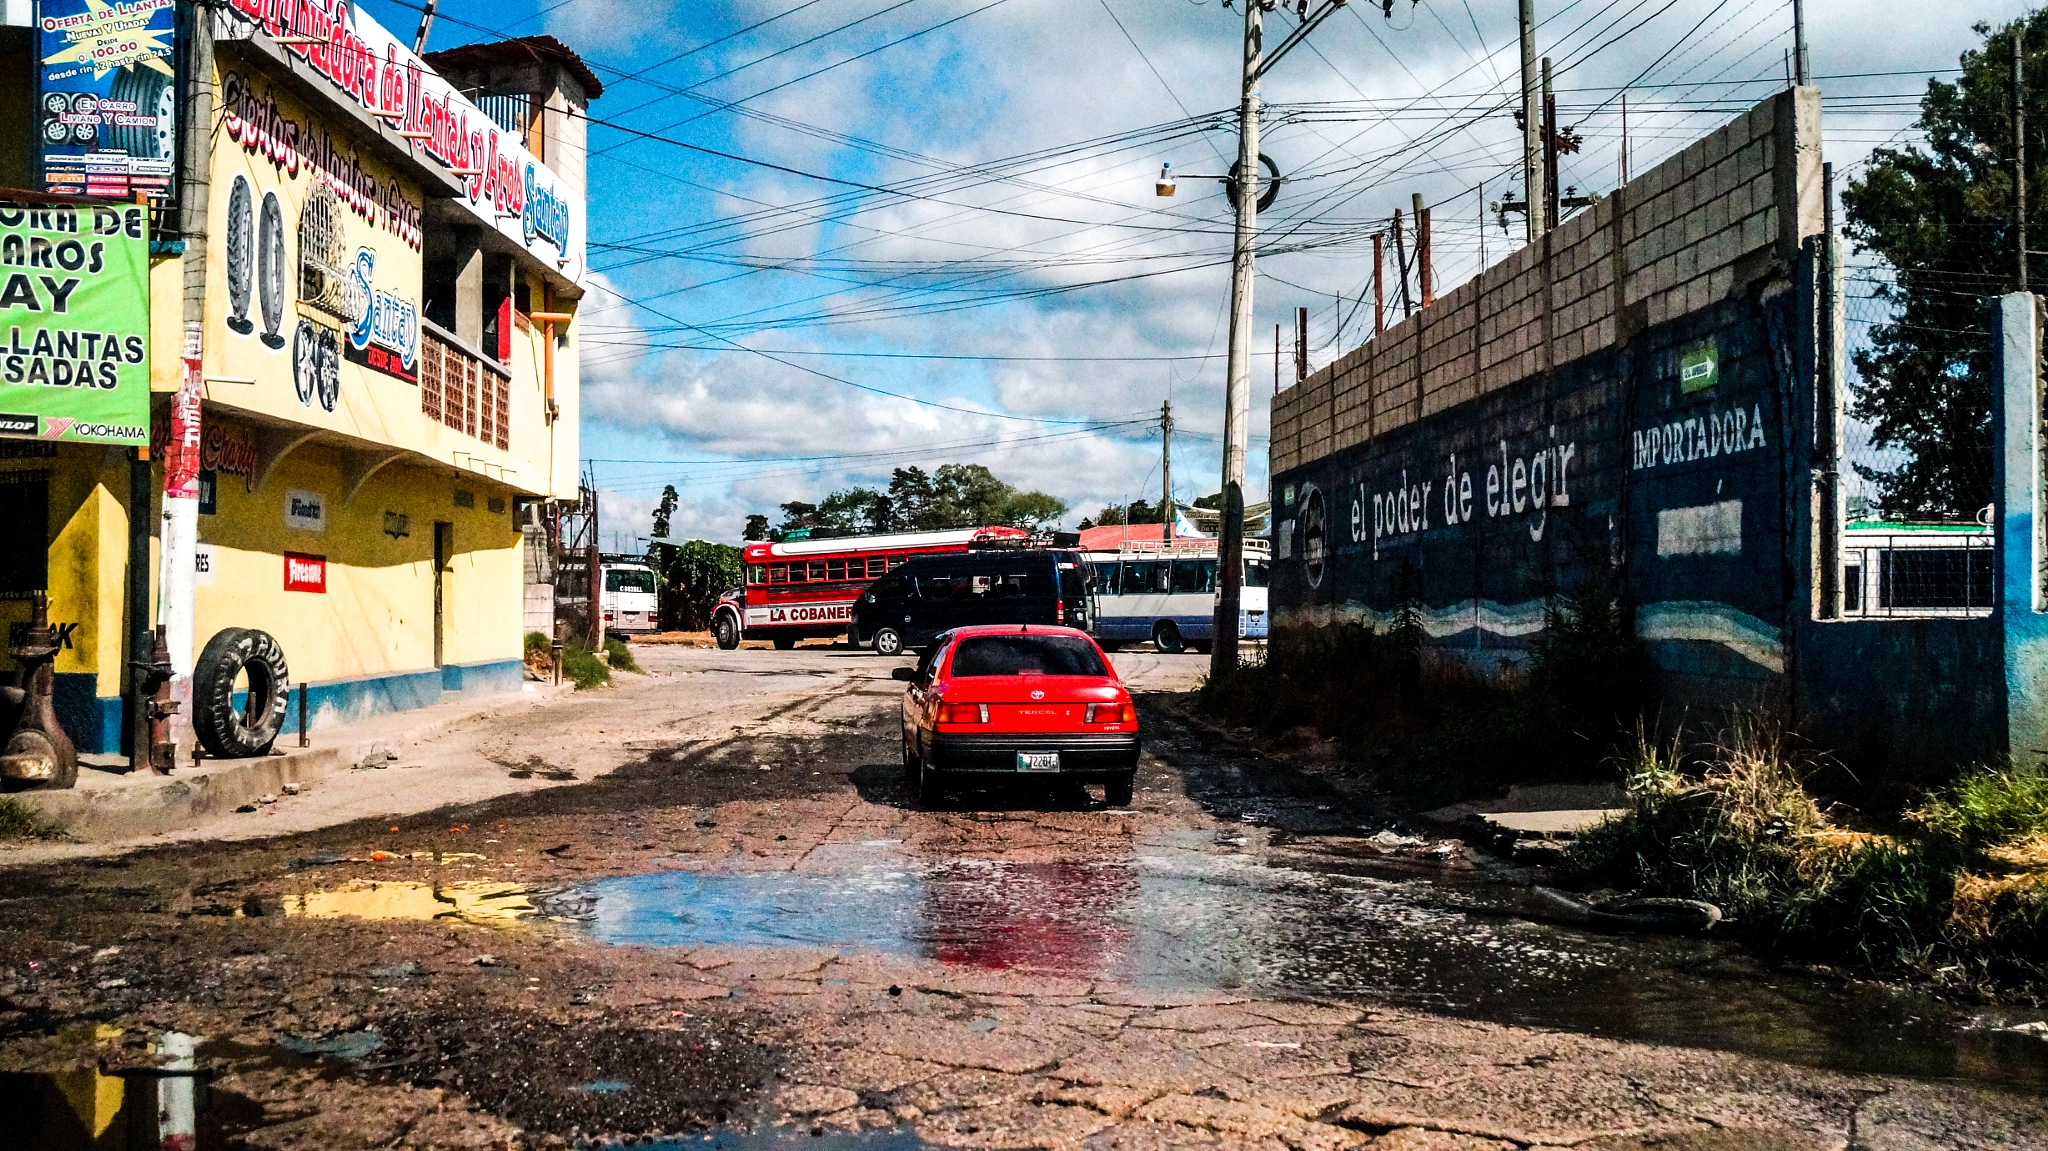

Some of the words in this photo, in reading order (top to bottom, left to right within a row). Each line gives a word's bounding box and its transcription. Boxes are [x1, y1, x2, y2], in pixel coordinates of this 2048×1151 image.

[43, 14, 94, 31] OFERTA
[98, 9, 114, 19] DE
[66, 28, 102, 42] NUEVAS
[103, 23, 112, 34] Y
[114, 18, 149, 31] USADAS
[91, 41, 137, 58] 100.00
[48, 70, 77, 81] desde
[80, 65, 93, 74] rin
[95, 61, 107, 71] 12
[108, 56, 135, 68] hasta
[136, 53, 150, 62] rin
[80, 99, 96, 110] EN
[99, 99, 137, 111] CARRO
[60, 112, 101, 124] LIVIANO
[103, 113, 113, 124] Y
[116, 114, 157, 126] CAMION
[381, 43, 404, 125] de
[485, 129, 522, 216] Aros
[93, 206, 142, 238] DE
[3, 234, 104, 273] AROS
[73, 423, 145, 438] YOKOHAMA
[1633, 403, 1767, 470] IMPORTADORA
[1351, 482, 1366, 542] el
[1373, 469, 1432, 561] poder
[1444, 453, 1473, 525] de
[1486, 425, 1575, 542] elegir
[770, 607, 787, 622] LA
